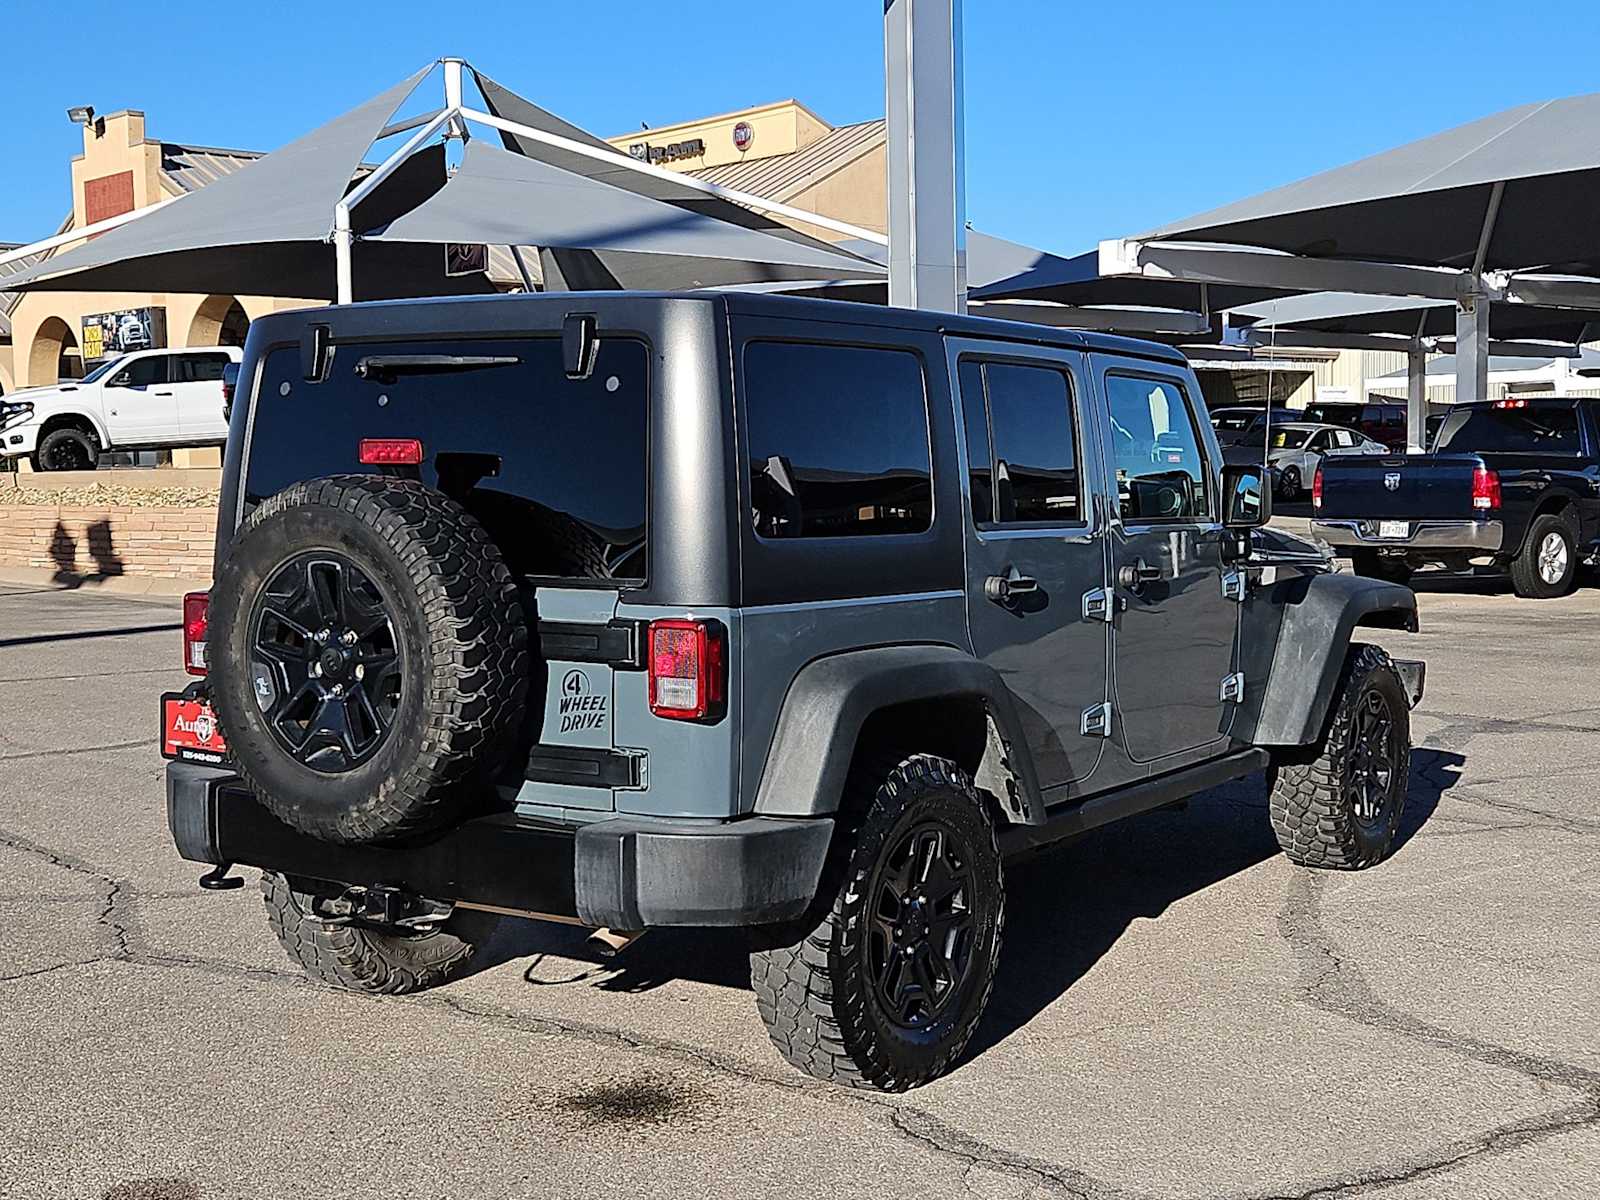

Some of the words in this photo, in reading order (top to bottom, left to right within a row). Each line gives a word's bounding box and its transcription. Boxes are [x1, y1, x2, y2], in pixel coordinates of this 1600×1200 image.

[567, 674, 581, 695] 4
[560, 696, 607, 714] WHEEL
[560, 713, 606, 732] DRIVE
